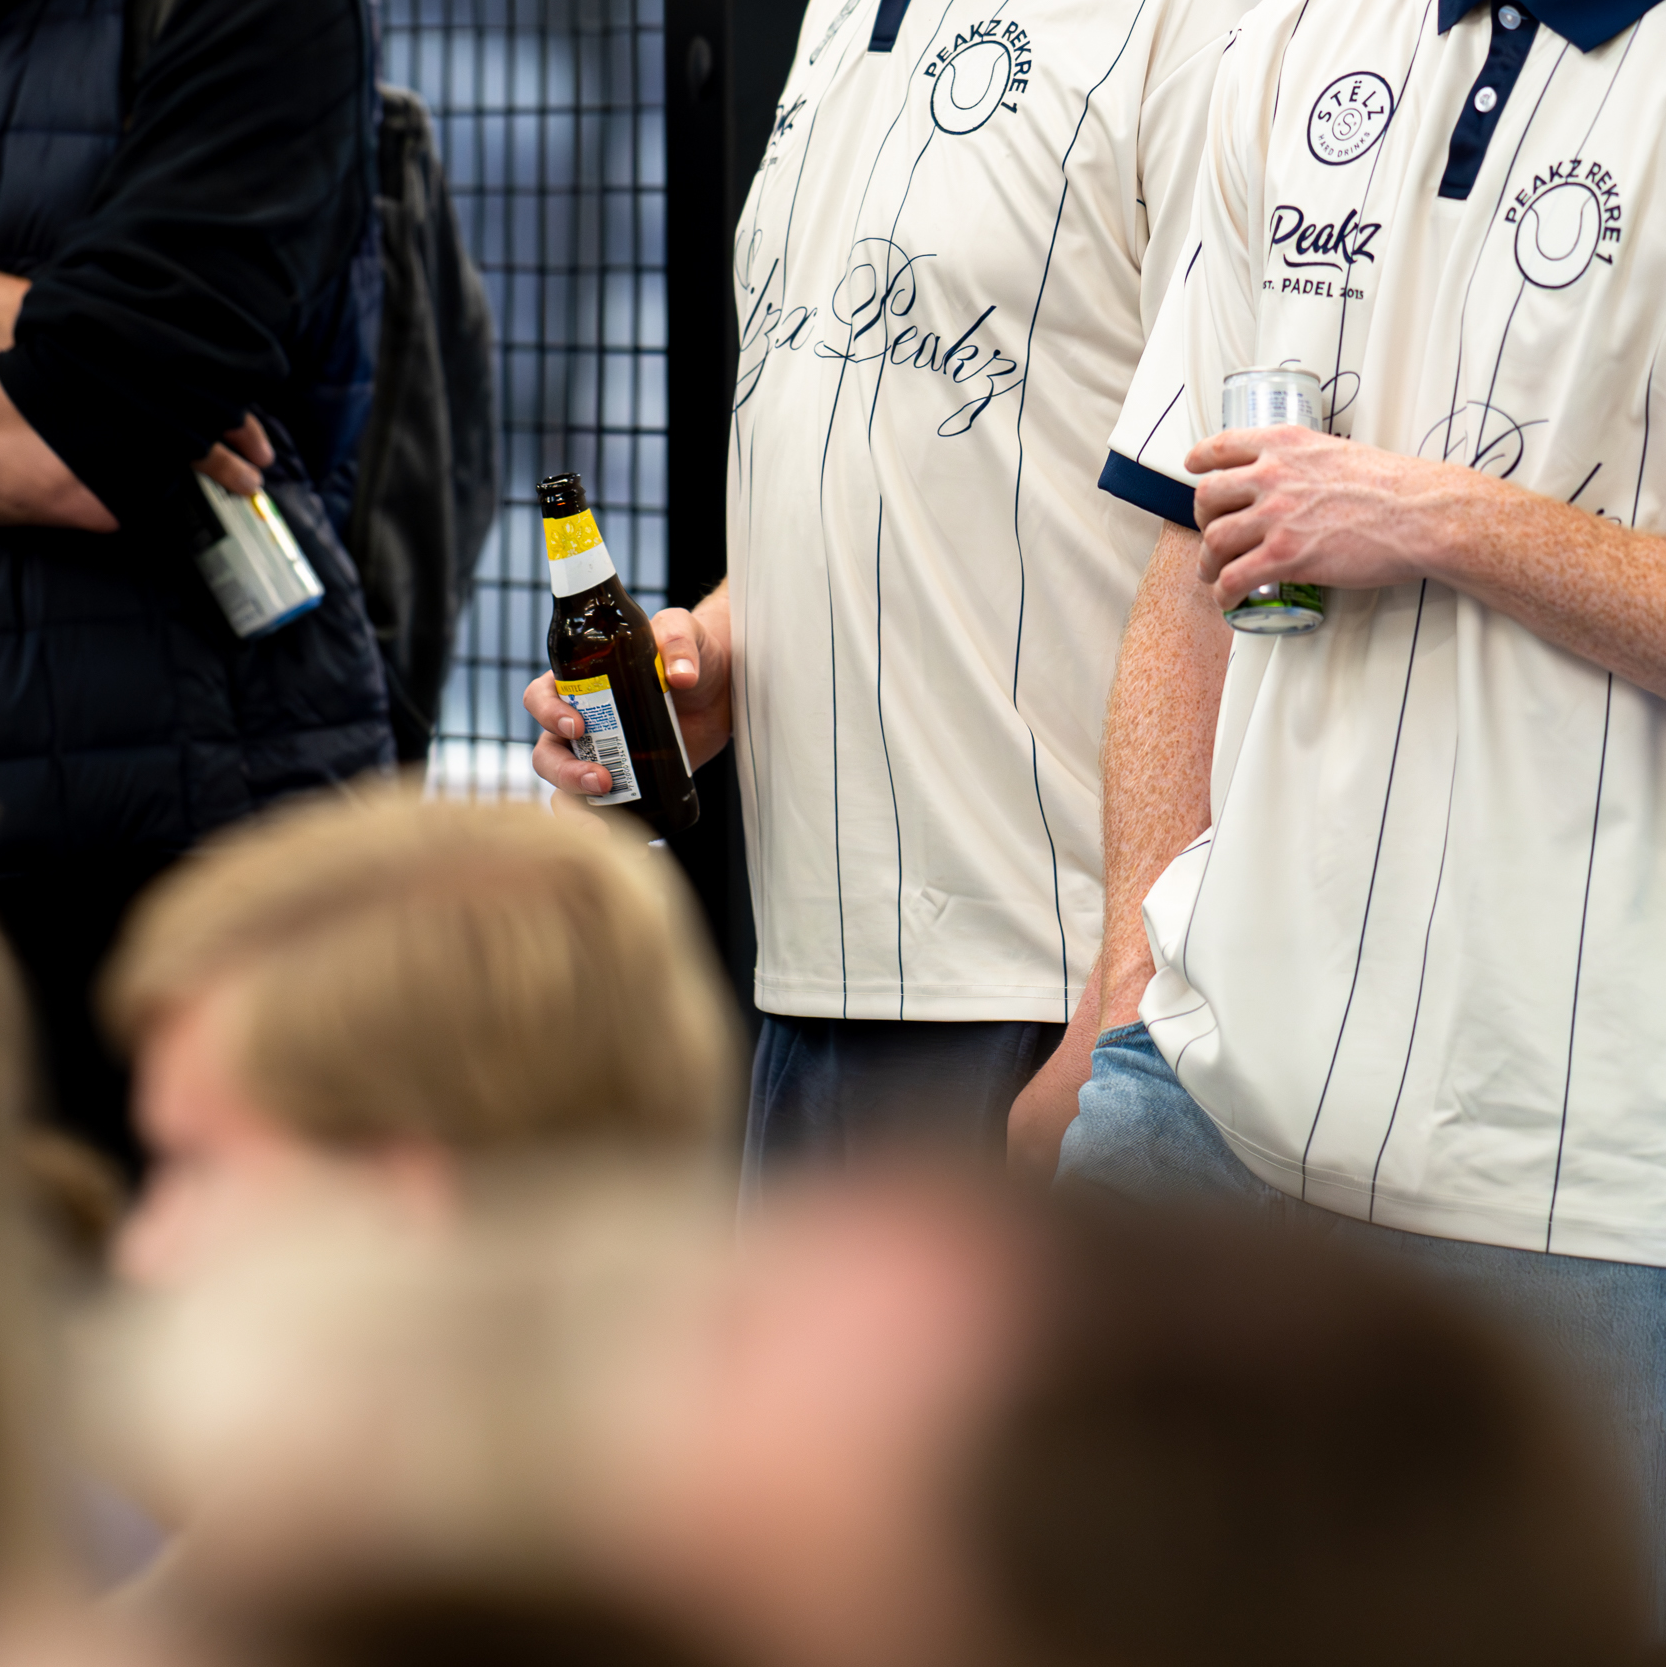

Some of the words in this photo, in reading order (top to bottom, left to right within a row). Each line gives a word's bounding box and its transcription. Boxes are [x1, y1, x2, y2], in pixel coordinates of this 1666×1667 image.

[923, 19, 1002, 78] PEAKZ
[1001, 20, 1032, 94] REKRE
[1000, 101, 1018, 114] 1
[1317, 80, 1384, 121] STËLZ
[1339, 112, 1355, 136] S
[1318, 133, 1335, 156] HARD
[1504, 159, 1582, 224] PEAKZ
[1585, 162, 1622, 243] REKRE
[1267, 205, 1382, 264] Peakz
[1595, 252, 1613, 265] 1
[1262, 280, 1275, 290] ST.
[1281, 278, 1334, 298] PADEL
[1338, 286, 1365, 300] 2015
[813, 237, 1023, 437] Peakz
